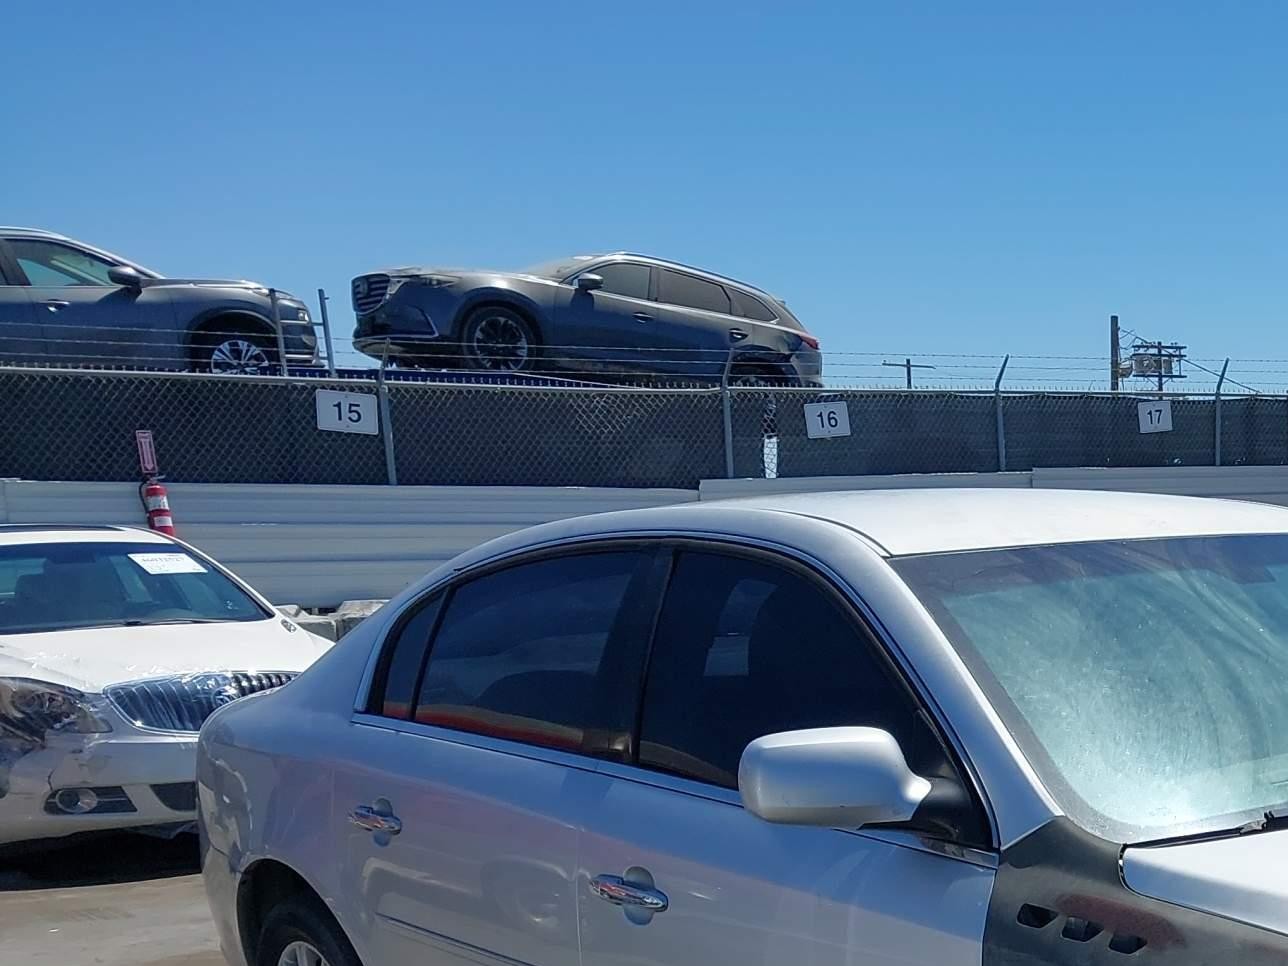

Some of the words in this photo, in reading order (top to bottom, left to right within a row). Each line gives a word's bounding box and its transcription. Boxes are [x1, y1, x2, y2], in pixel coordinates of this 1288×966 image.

[332, 401, 362, 423] 15
[817, 410, 838, 428] 16
[1147, 409, 1163, 425] 17
